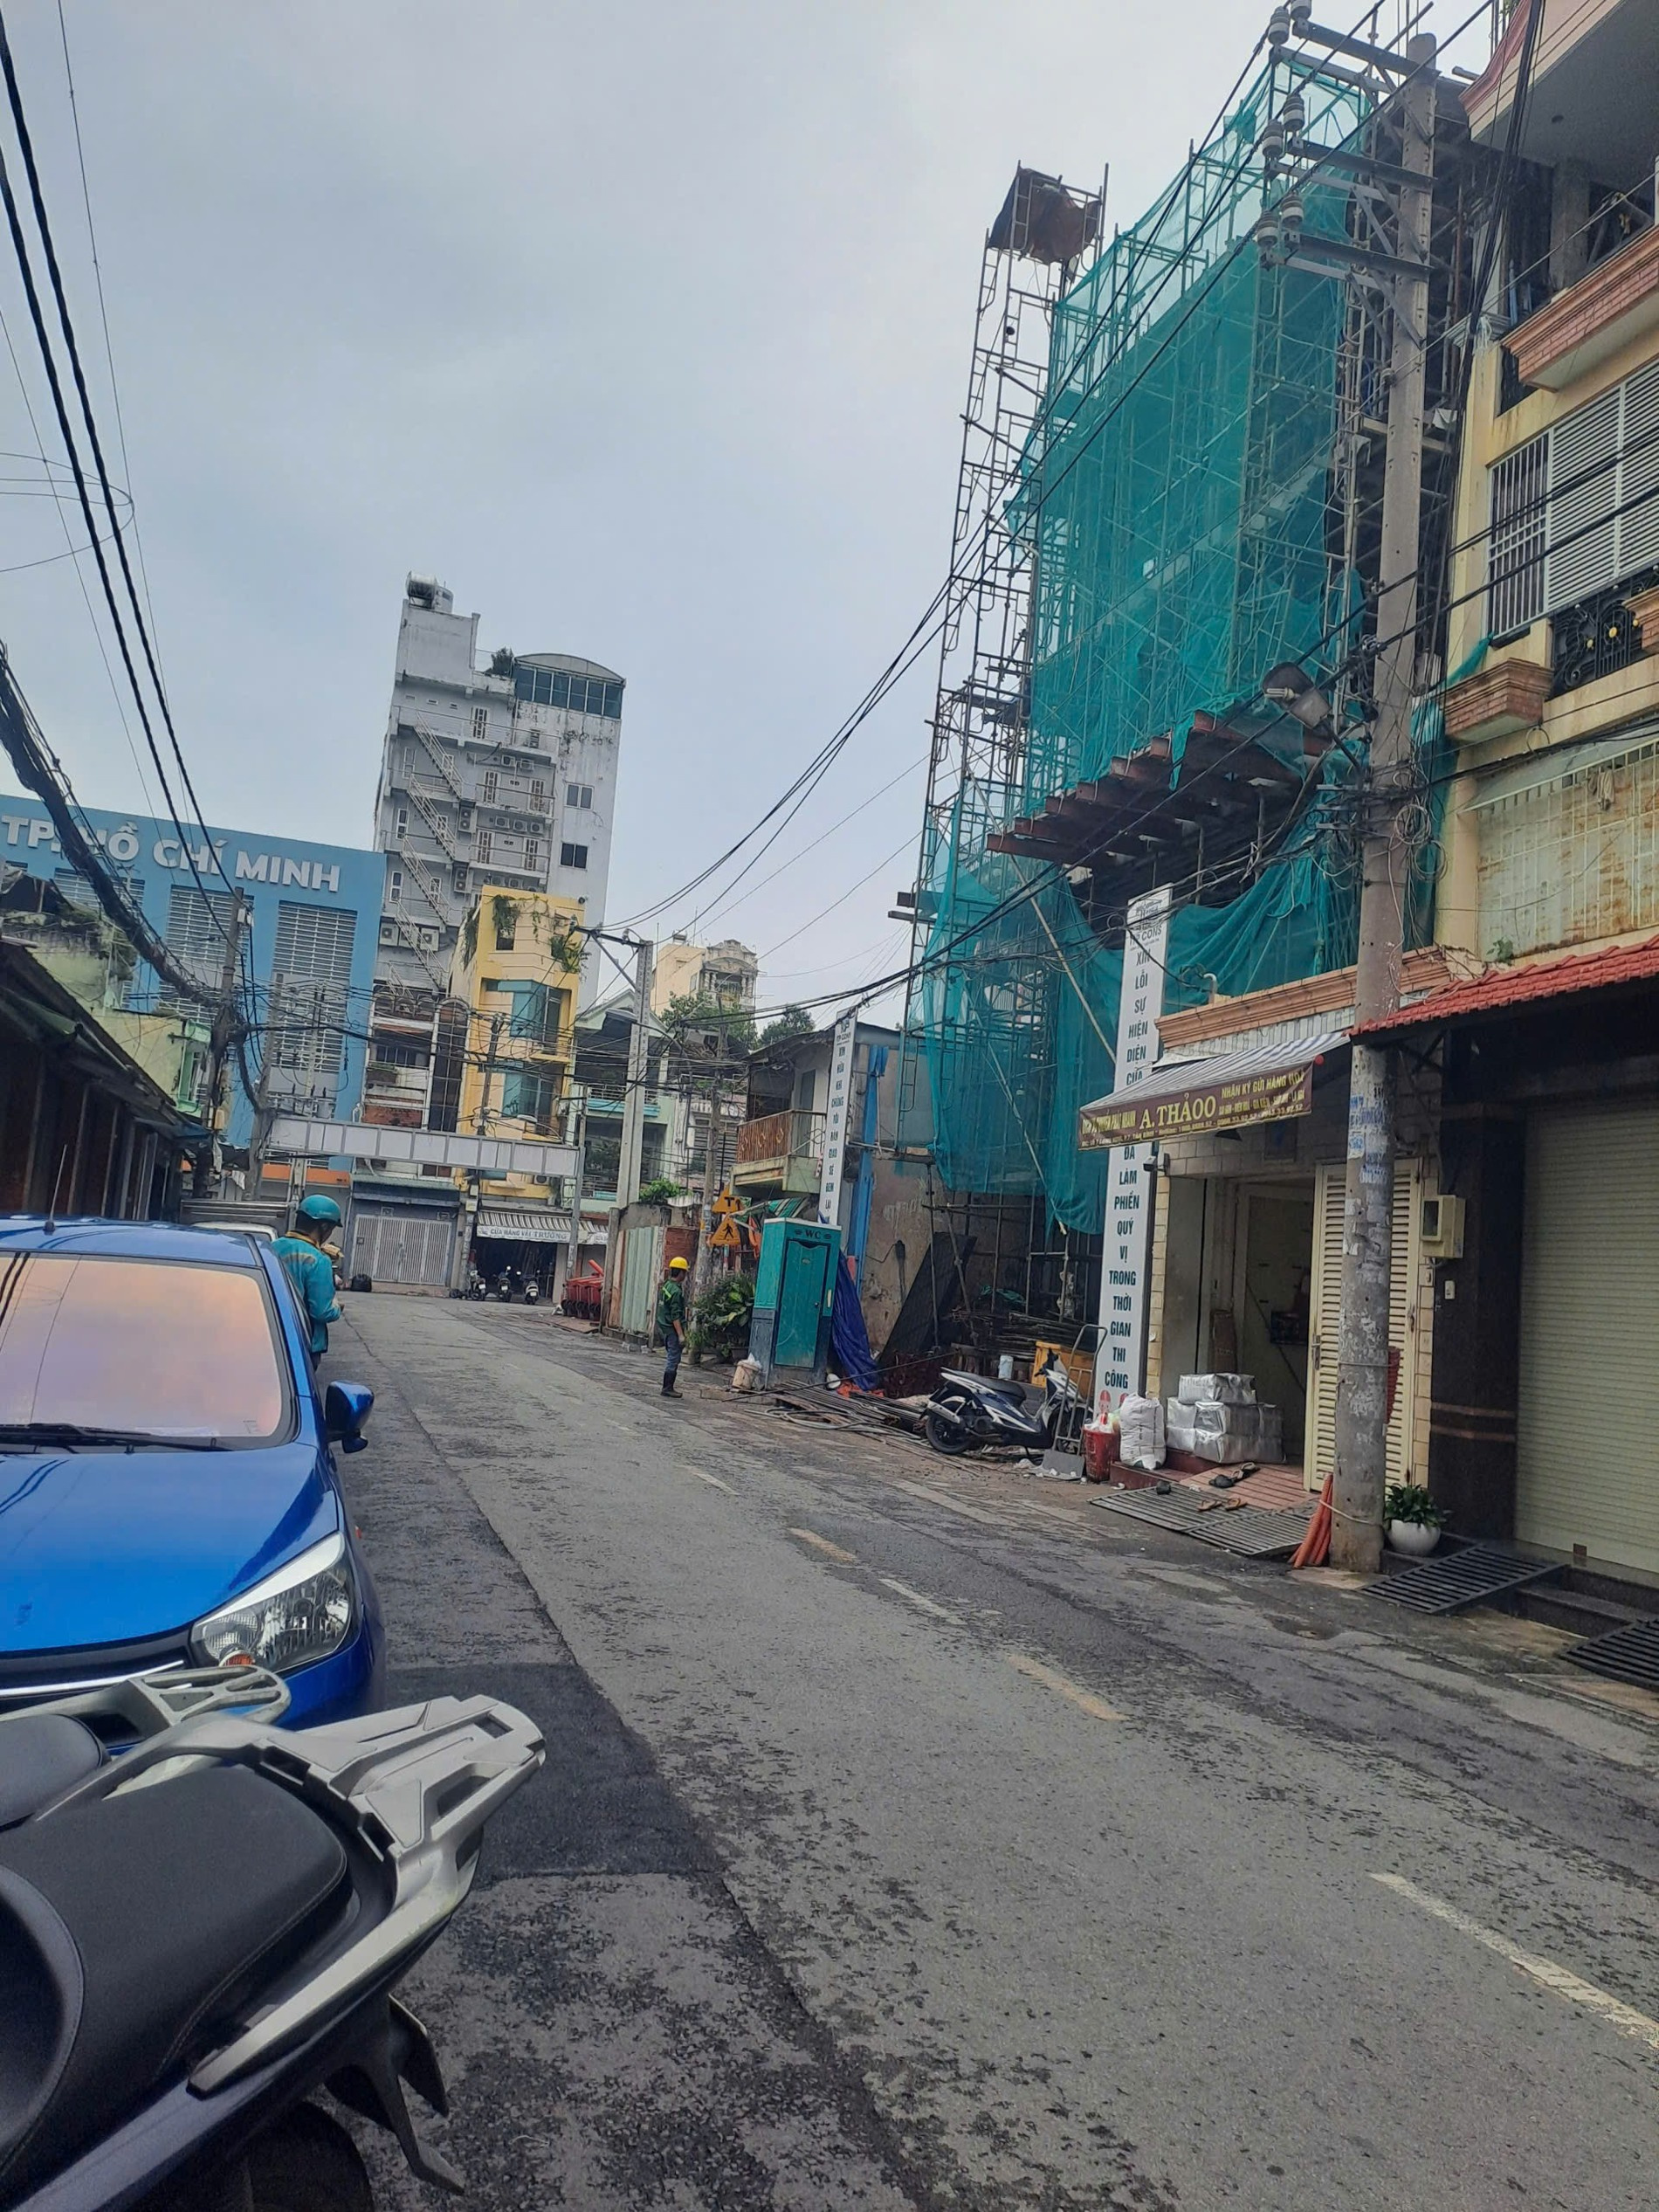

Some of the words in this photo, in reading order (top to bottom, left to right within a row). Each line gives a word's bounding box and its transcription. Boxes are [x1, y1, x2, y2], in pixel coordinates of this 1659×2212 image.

[153, 838, 227, 875] CHÍ
[235, 851, 341, 893] MINH
[1134, 996, 1146, 1015] SỰ
[1128, 1019, 1148, 1039] HIỆN
[1126, 1044, 1146, 1064] DIỆN
[1266, 1074, 1287, 1091] HÀNG
[1119, 1168, 1138, 1185] LÀM
[805, 1230, 822, 1240] WC
[1117, 1216, 1134, 1236] QUÝ
[1119, 1245, 1128, 1264] VỊ
[1109, 1270, 1137, 1286] TRONG
[1112, 1292, 1132, 1312] THỜI
[1110, 1320, 1132, 1337] GIAN
[1112, 1347, 1126, 1362] THI
[1105, 1368, 1128, 1389] CÔNG
